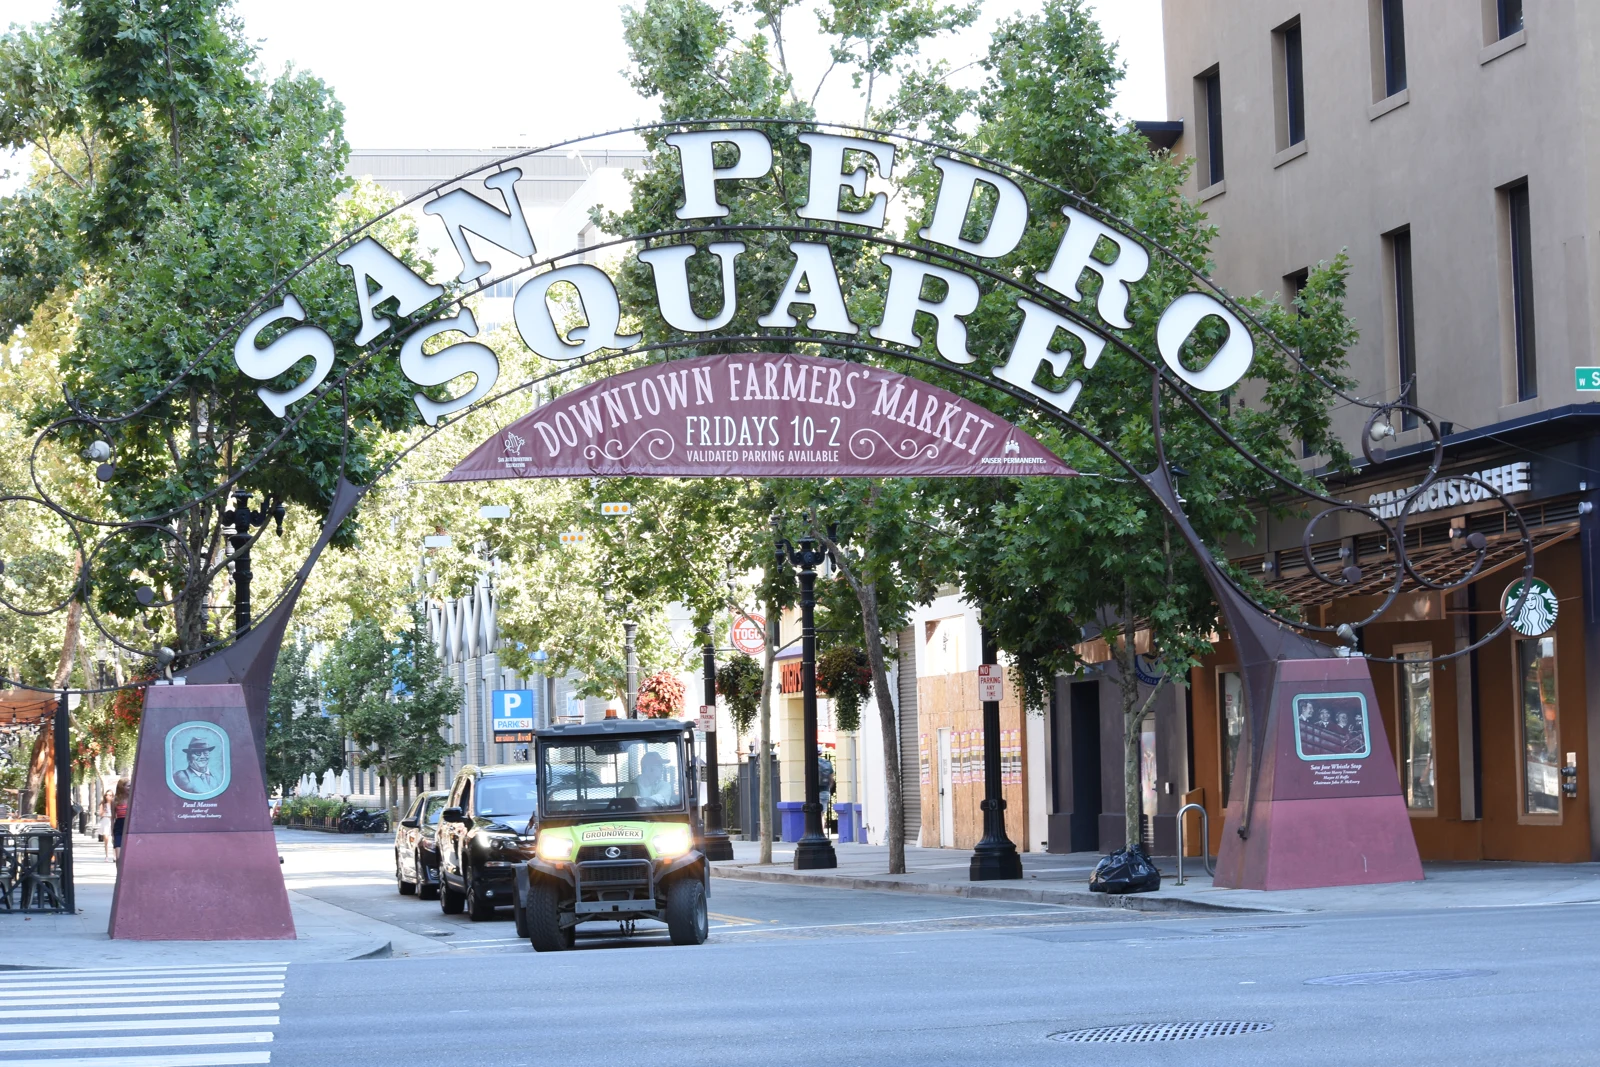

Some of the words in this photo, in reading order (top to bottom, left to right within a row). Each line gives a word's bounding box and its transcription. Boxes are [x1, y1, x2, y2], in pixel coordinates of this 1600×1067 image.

[234, 167, 537, 419] SAN
[665, 128, 1255, 393] PEDRO
[400, 241, 1107, 427] SQUARE
[1579, 377, 1586, 387] W
[533, 366, 714, 458] DOWNTOWN
[728, 362, 870, 409] FARMERS'
[872, 379, 995, 456] MARKET
[685, 415, 780, 447] FRIDAYS
[790, 415, 841, 447] 10-2
[686, 450, 739, 462] VALIDATED
[742, 450, 784, 462] PARKING
[788, 450, 839, 462] AVAILABLE
[1369, 478, 1458, 520] STARBUCKS
[1459, 461, 1532, 503] COFFEE
[979, 666, 989, 675] NO
[980, 676, 1001, 684] PARKING
[504, 693, 522, 717] P
[585, 830, 640, 838] GROUNDWERX
